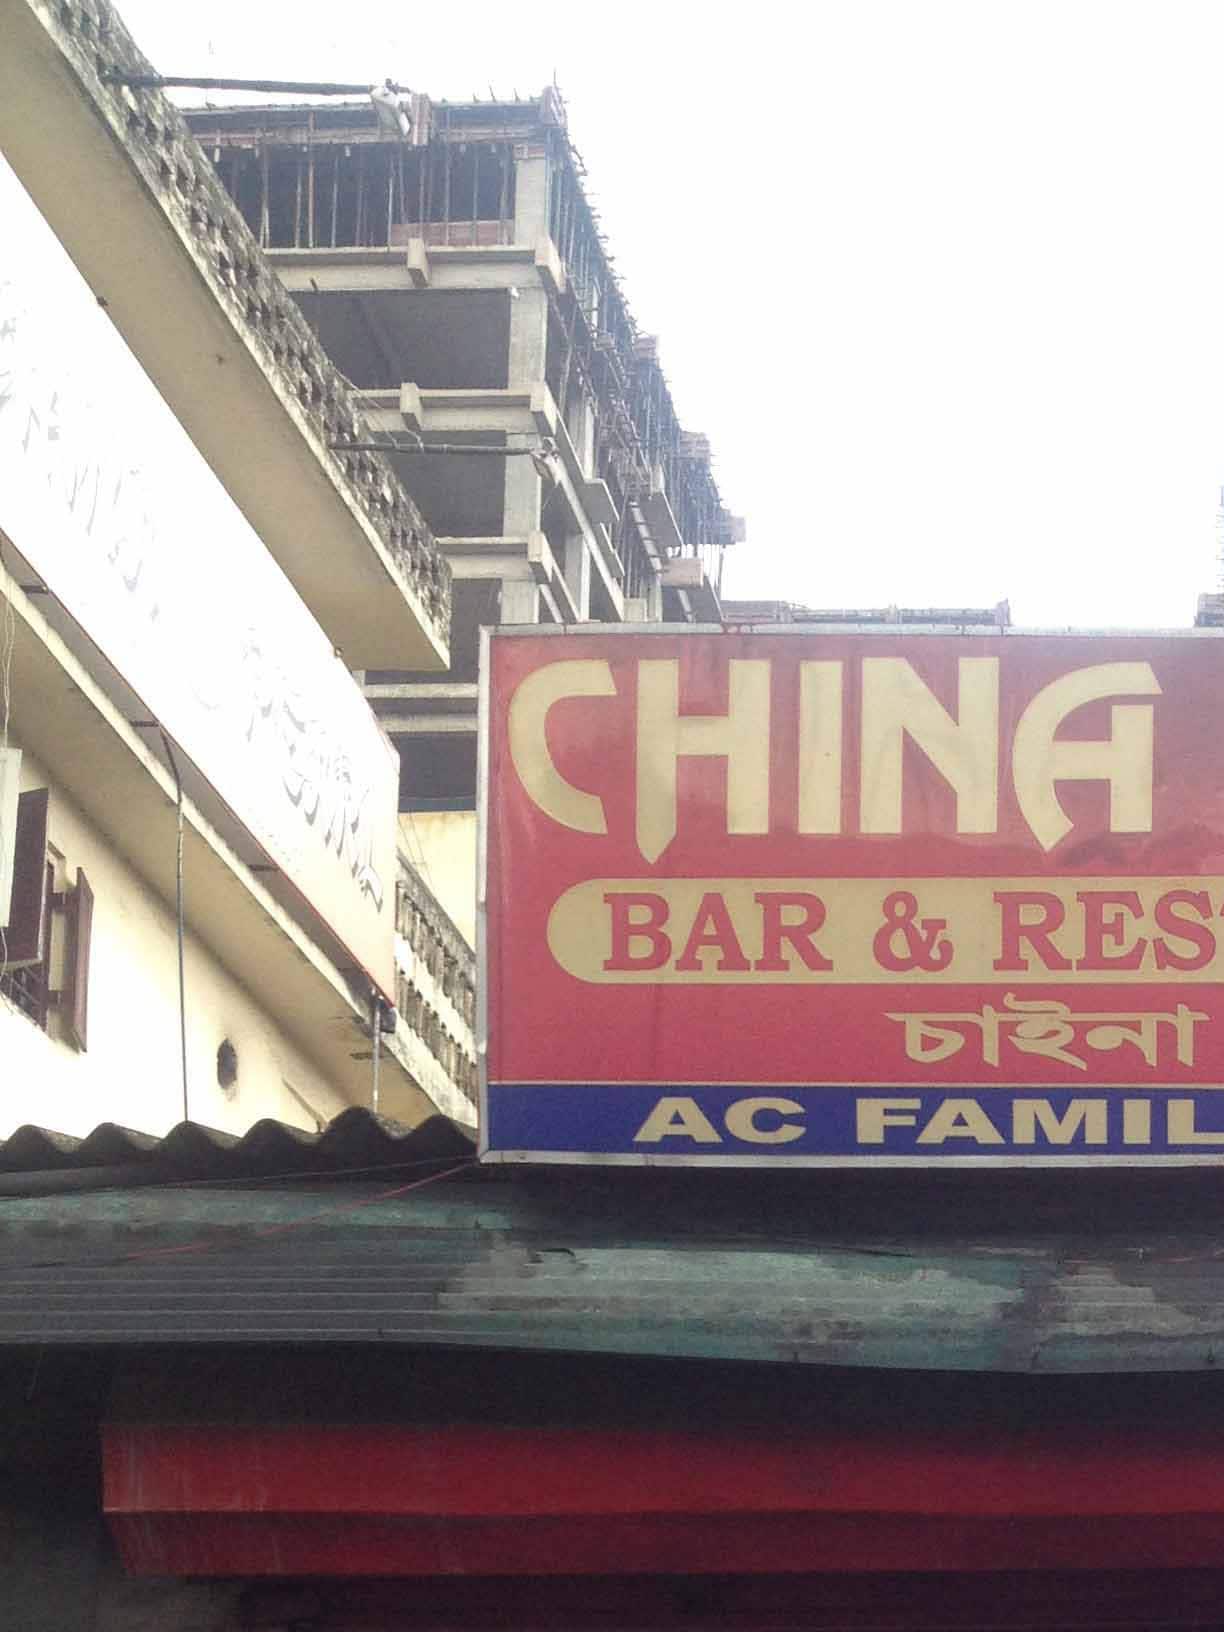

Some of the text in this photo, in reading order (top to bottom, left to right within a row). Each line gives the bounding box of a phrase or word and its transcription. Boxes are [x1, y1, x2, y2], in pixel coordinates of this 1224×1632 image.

[508, 656, 1163, 864] CHINA
[602, 891, 833, 972] BAR
[872, 888, 954, 973] &
[883, 991, 1211, 1071] চাইনা
[632, 1096, 808, 1144] AC
